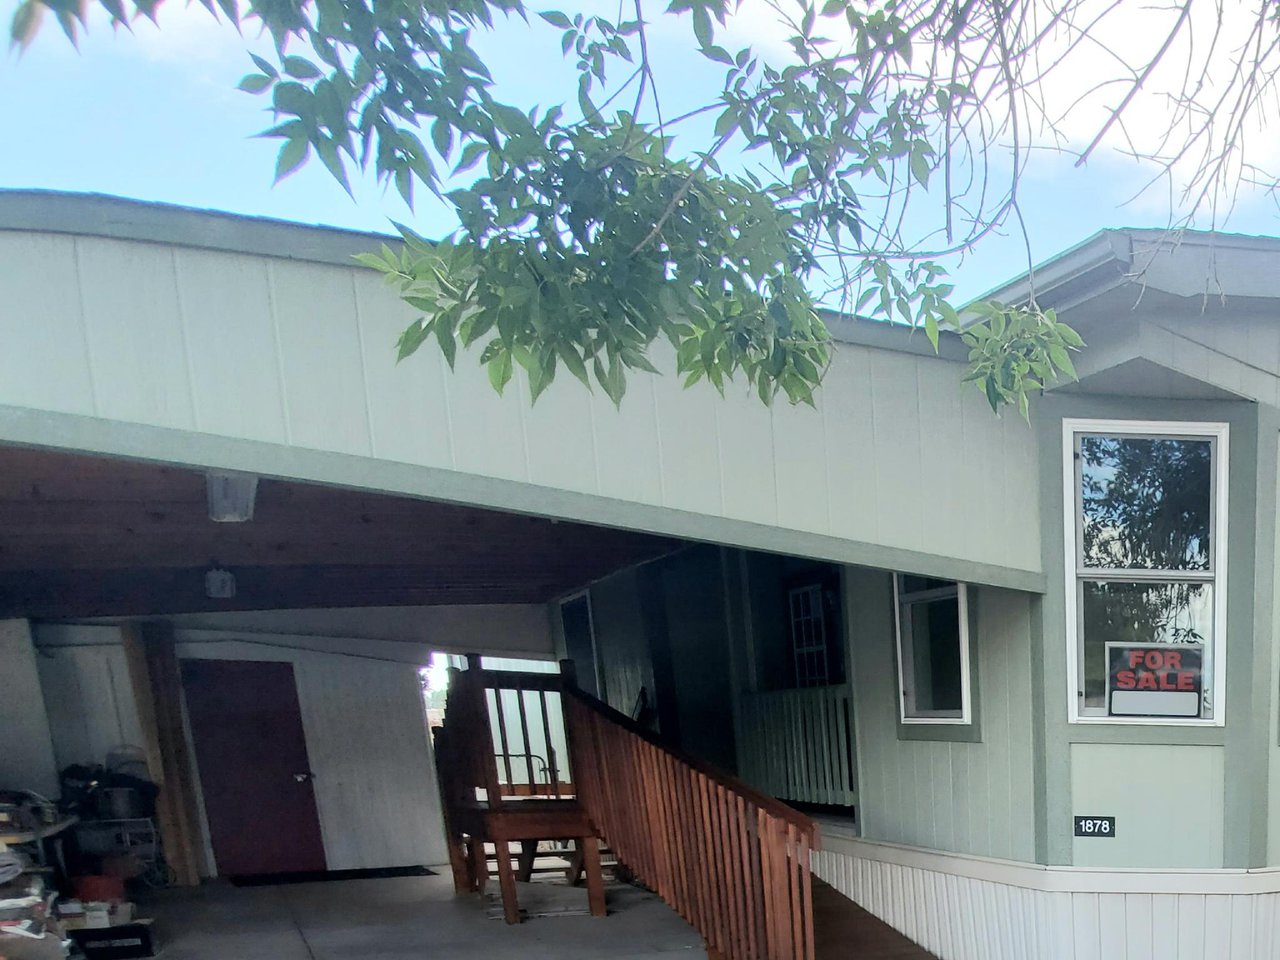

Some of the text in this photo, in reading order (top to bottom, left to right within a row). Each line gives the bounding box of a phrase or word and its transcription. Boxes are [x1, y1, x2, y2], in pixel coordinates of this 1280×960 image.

[1129, 650, 1182, 670] FOR
[1116, 671, 1196, 690] SALE
[1079, 819, 1110, 833] 1878
